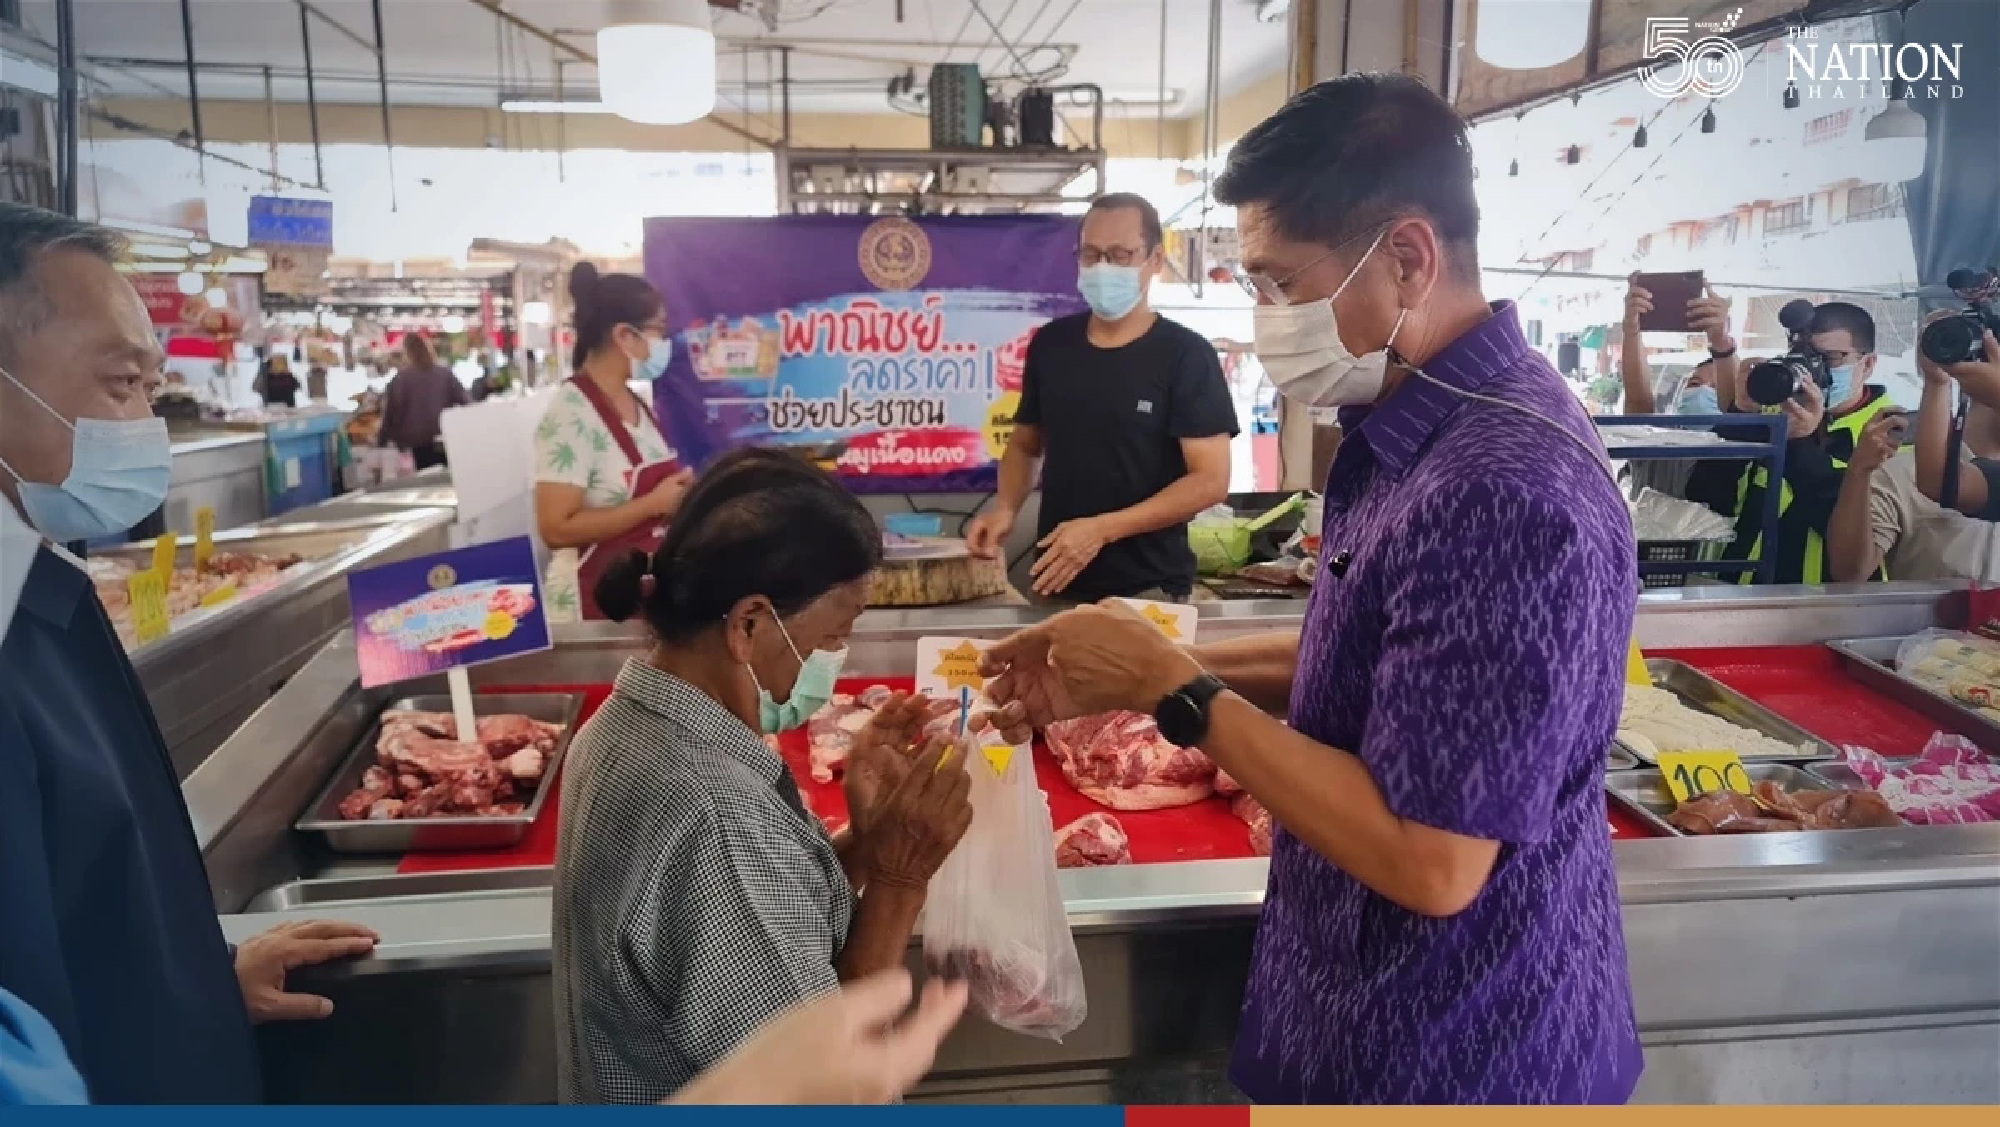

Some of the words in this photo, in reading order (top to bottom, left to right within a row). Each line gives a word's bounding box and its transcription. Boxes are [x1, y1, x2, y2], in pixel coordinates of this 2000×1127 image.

[772, 387, 944, 428] ช่วยประชาชน
[1673, 762, 1753, 800] 100
